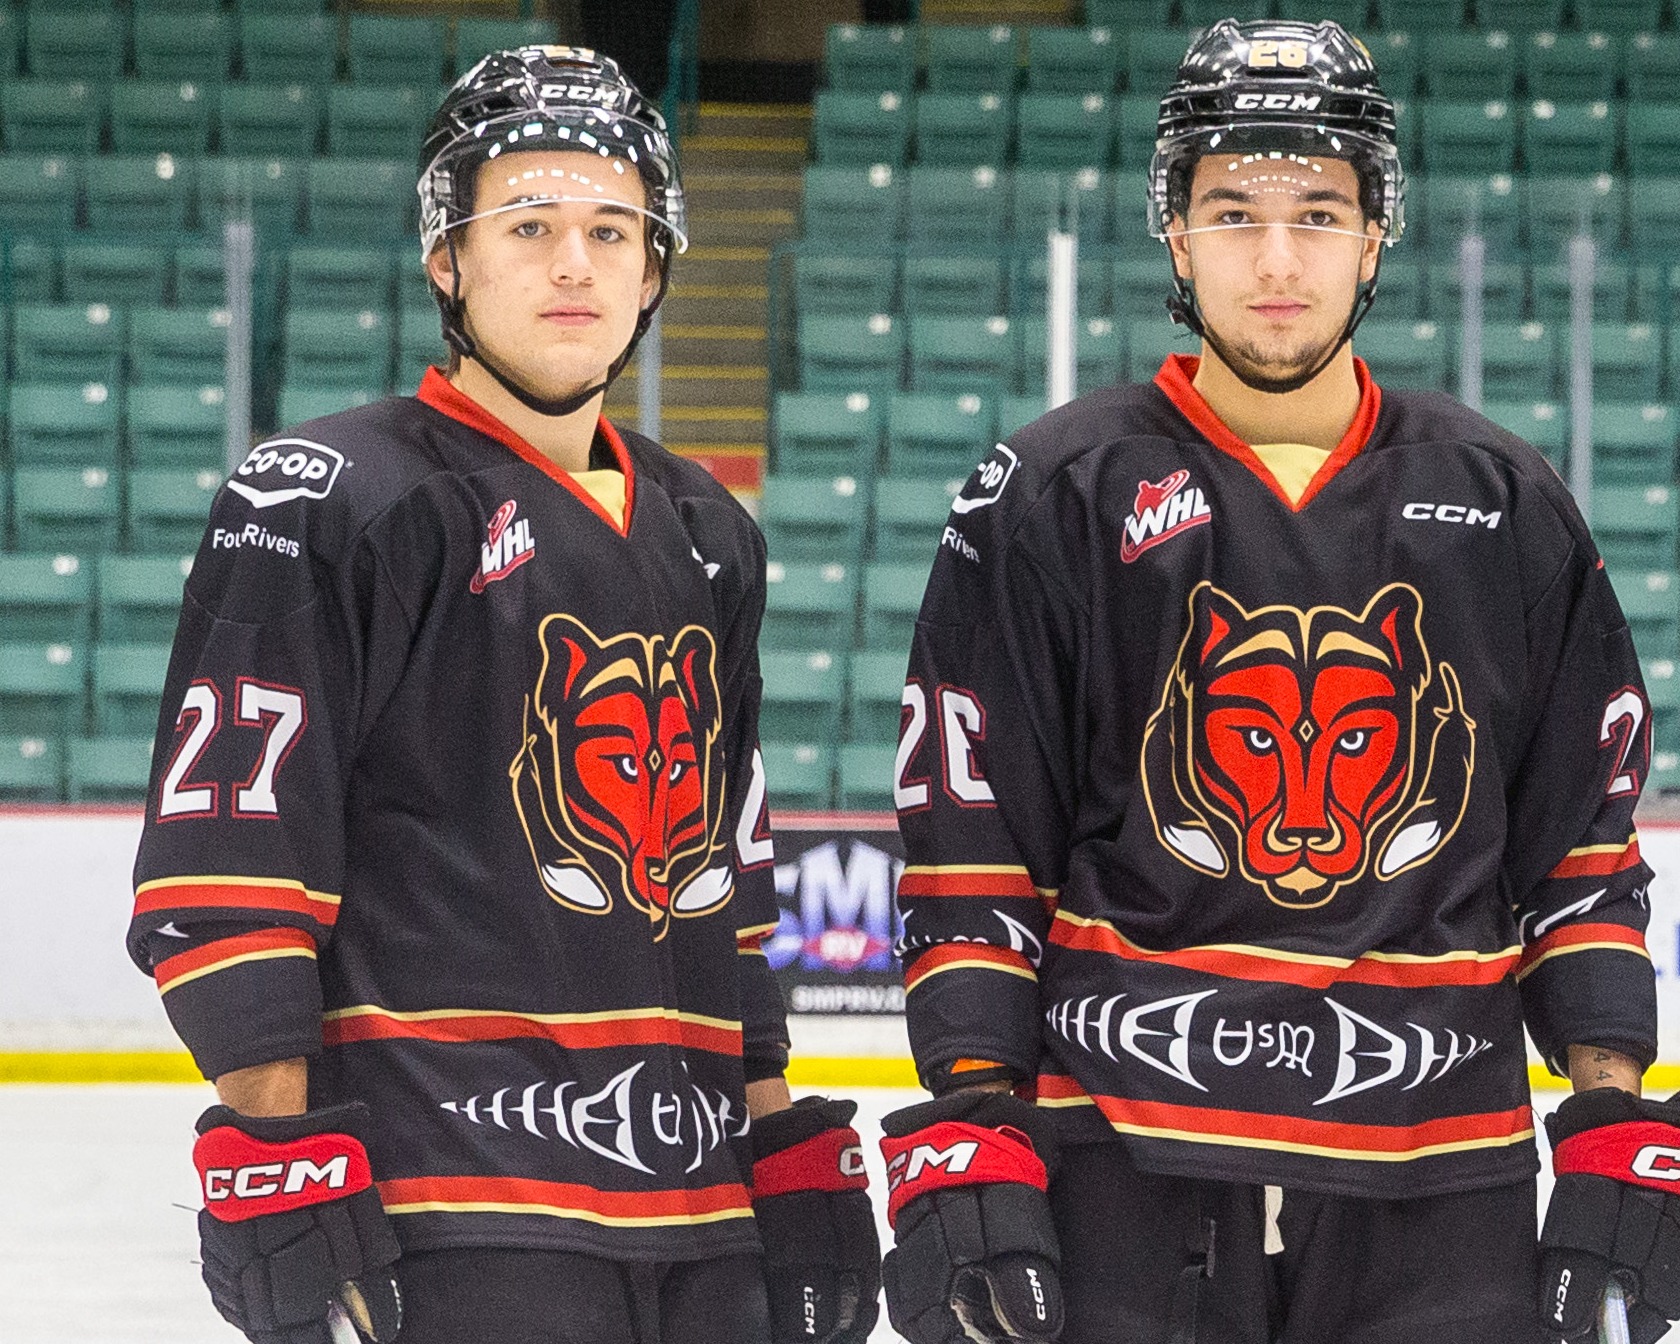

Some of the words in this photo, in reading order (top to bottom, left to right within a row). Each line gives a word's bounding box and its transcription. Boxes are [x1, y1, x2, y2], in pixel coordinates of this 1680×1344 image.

[540, 84, 620, 104] CCM
[1233, 93, 1322, 111] CCM
[1124, 488, 1212, 546] WHL
[1402, 502, 1502, 529] CCM
[159, 680, 304, 820] 27
[205, 1155, 348, 1200] CCM
[804, 1286, 815, 1334] CCM
[1026, 1267, 1046, 1321] CCM
[1554, 1268, 1572, 1322] CCM
